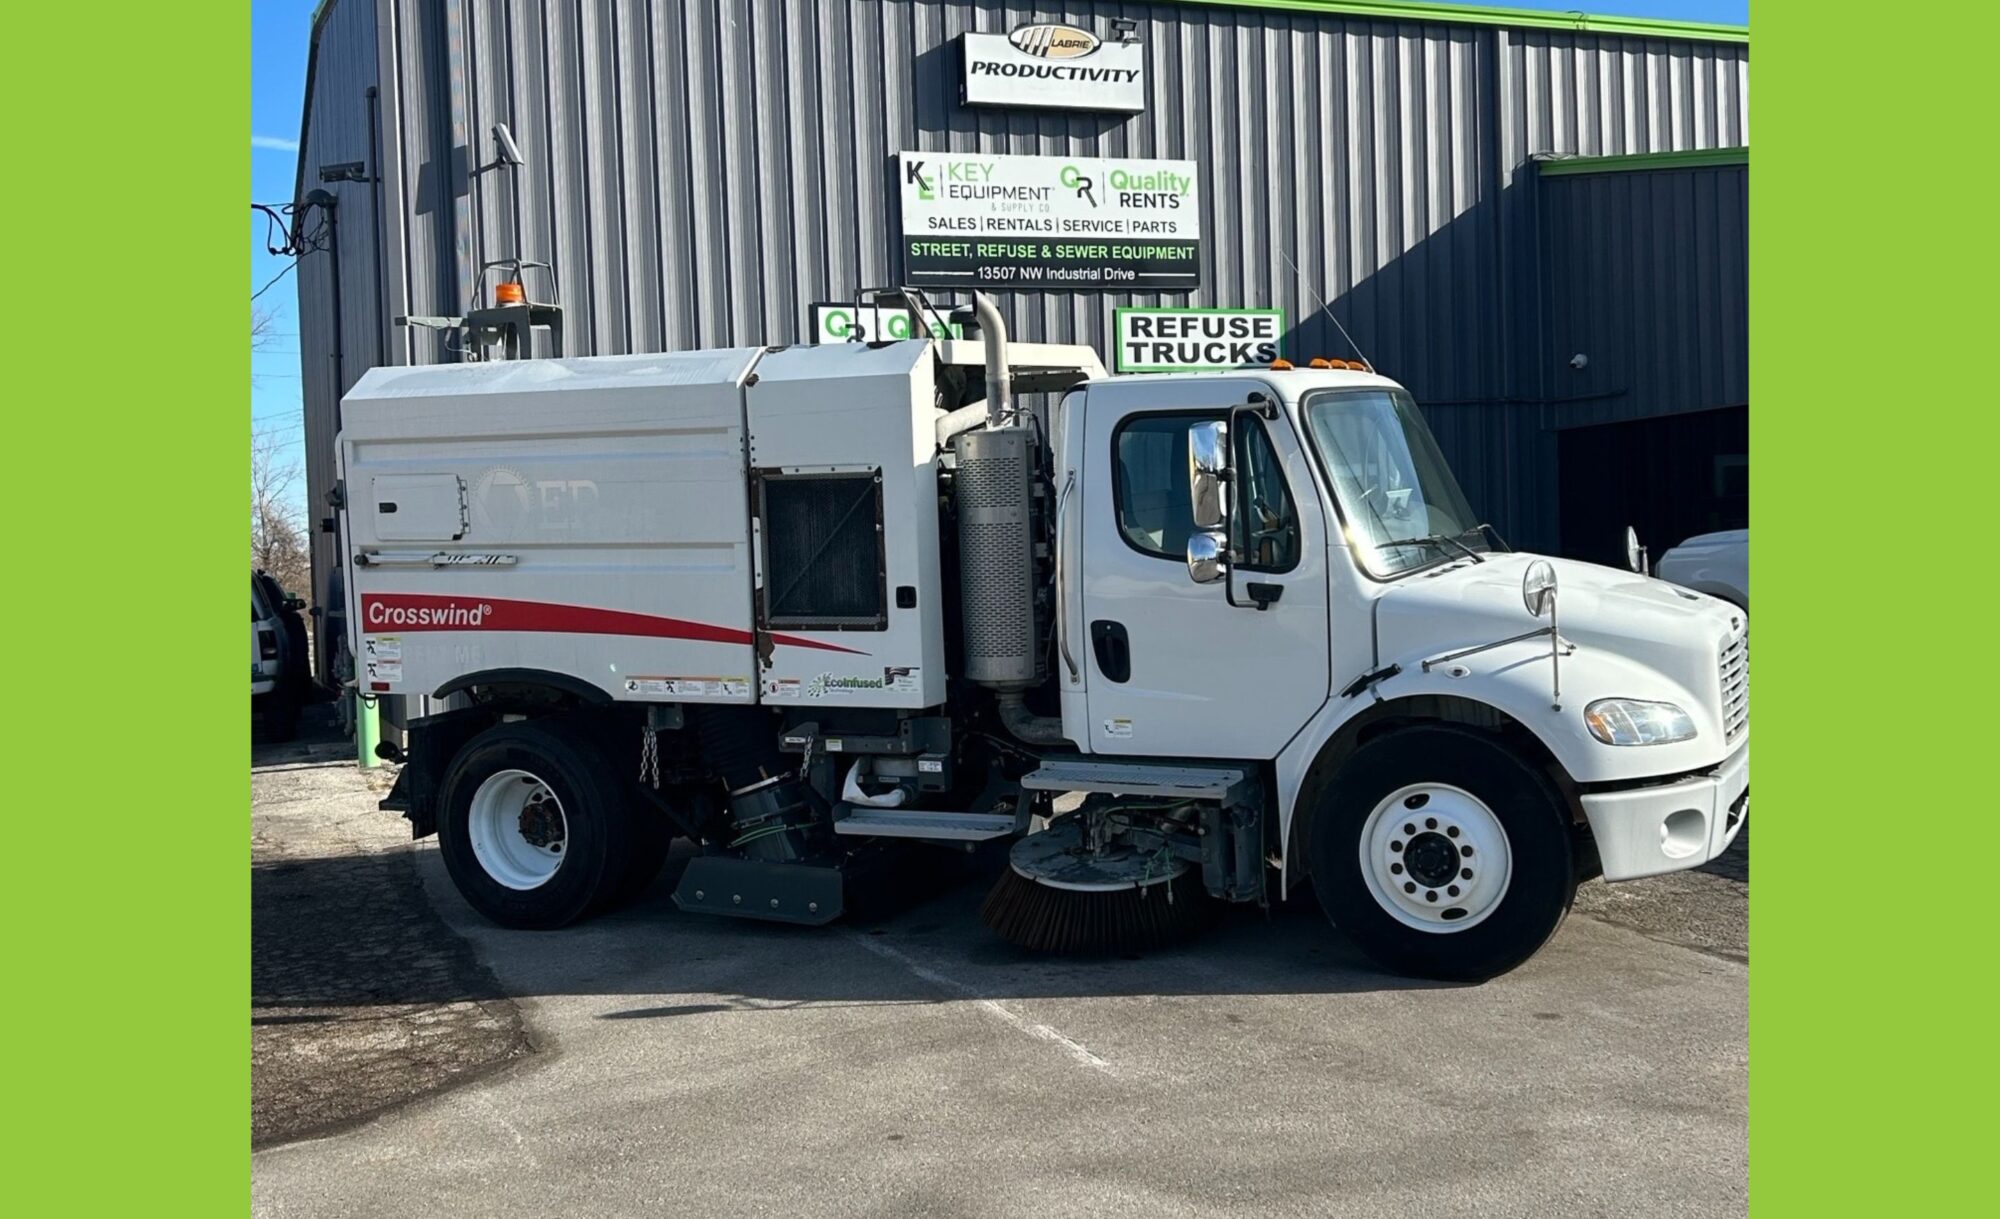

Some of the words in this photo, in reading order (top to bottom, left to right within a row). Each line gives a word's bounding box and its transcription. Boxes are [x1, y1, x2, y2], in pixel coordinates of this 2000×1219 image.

[1051, 38, 1090, 49] LABRIE
[971, 60, 1139, 83] PRODUCTIVITY
[948, 162, 994, 181] KEY
[1110, 169, 1190, 196] Quality
[949, 184, 1050, 200] EQUIPMENT
[1120, 192, 1180, 209] RENTS
[1001, 202, 1033, 213] SUPPLY
[928, 216, 977, 230] SALES
[986, 218, 1053, 231] RENTALS
[1063, 219, 1123, 232] SERVICE
[1133, 220, 1177, 233] PARTS
[911, 243, 973, 259] STREET,
[977, 244, 1037, 258] REFUSE
[1041, 245, 1052, 258] &
[1055, 246, 1108, 259] SEWER
[1112, 246, 1195, 260] EQUIPMENT
[978, 266, 1016, 279] 13507
[1020, 267, 1043, 280] NW
[1046, 267, 1101, 280] Industrial
[1104, 268, 1135, 281] Drive
[1131, 316, 1273, 339] REFUSE
[1126, 342, 1278, 364] TRUCKS
